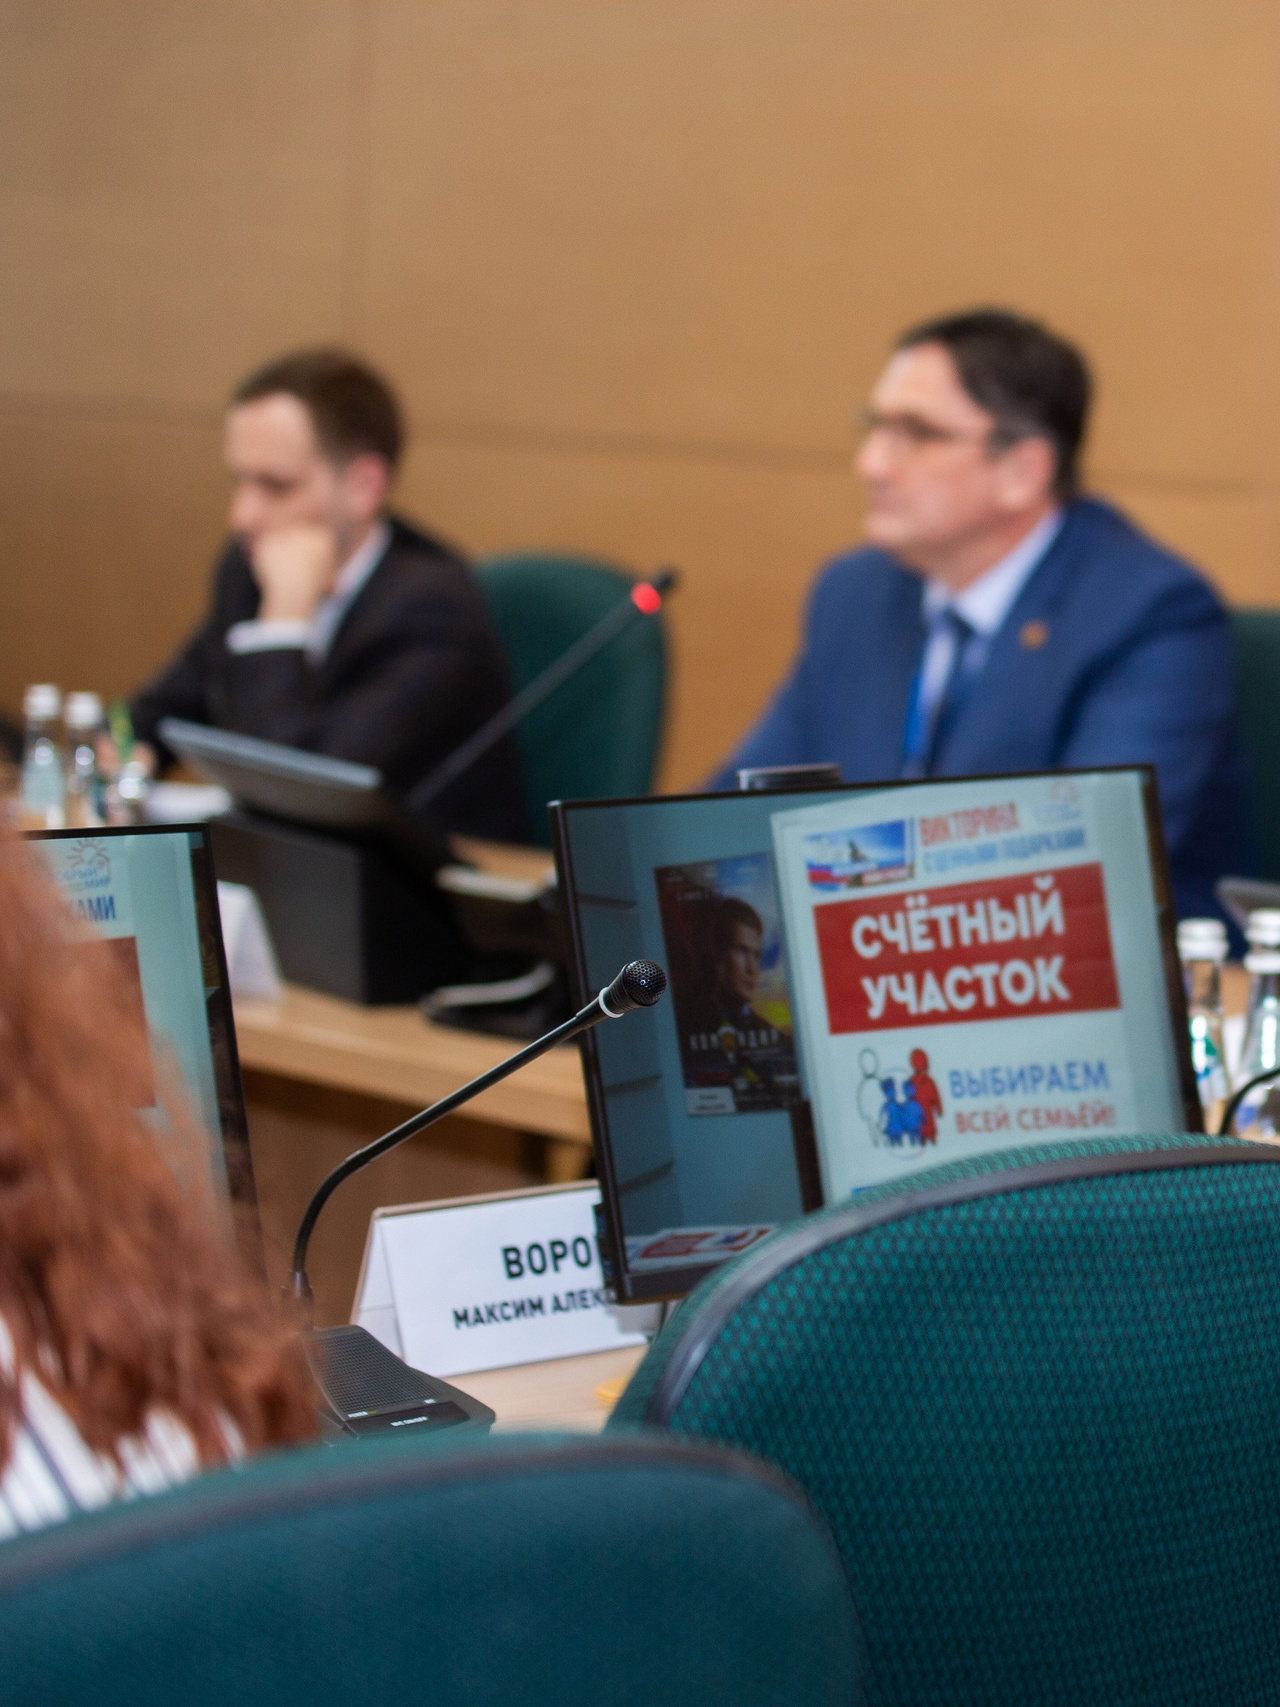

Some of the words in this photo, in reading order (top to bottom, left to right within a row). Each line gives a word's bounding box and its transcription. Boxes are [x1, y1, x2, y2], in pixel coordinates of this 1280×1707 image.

[852, 874, 1065, 959] СЧЁТНЫЙ
[861, 955, 1071, 1020] УЧАСТОК
[949, 1060, 1110, 1099] ВЫБИРАЕМ
[955, 1104, 1010, 1134] ВСЕЙ
[452, 1296, 545, 1329] МАКСИМ
